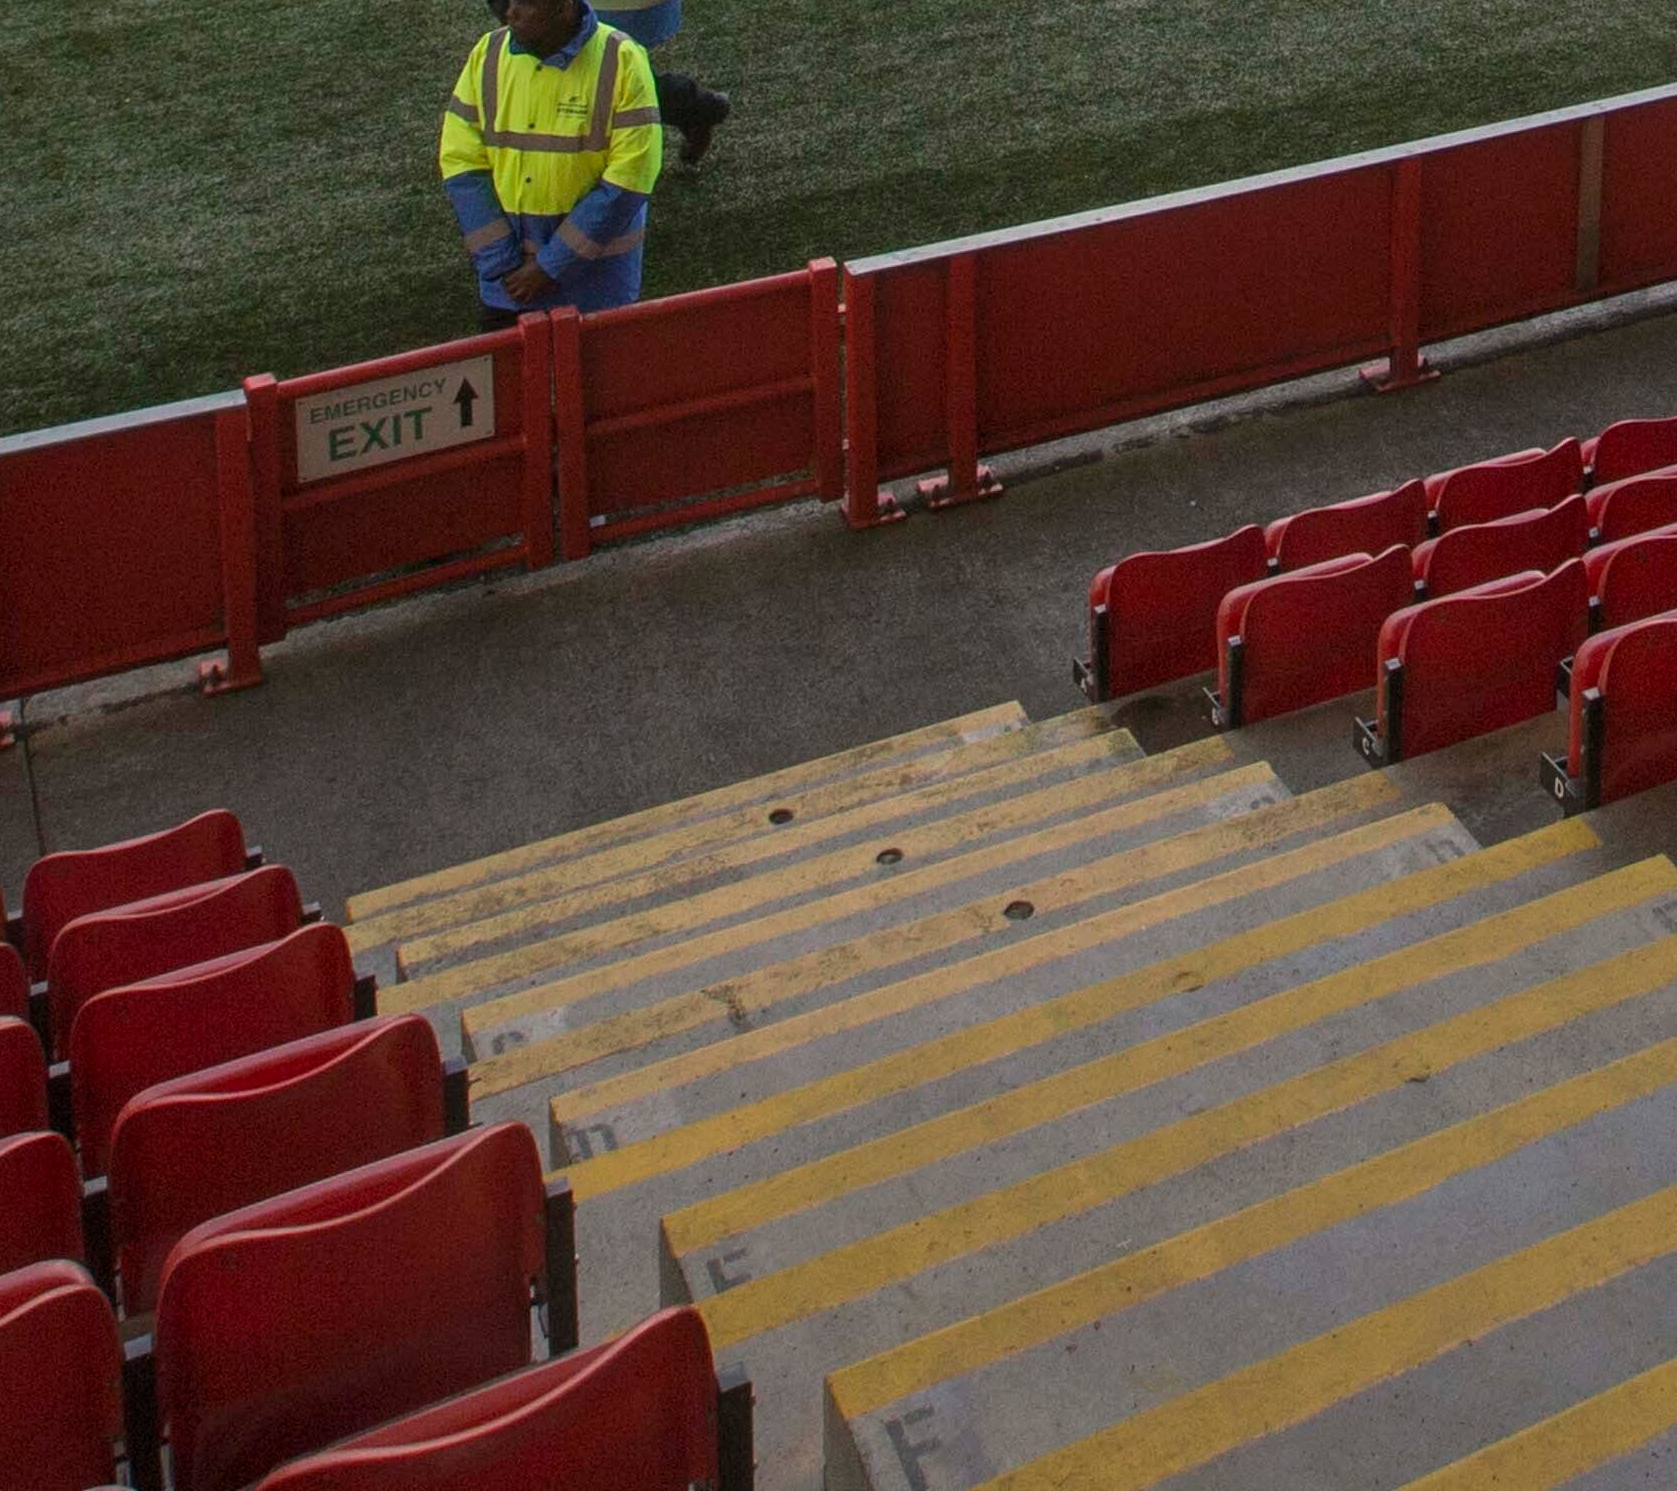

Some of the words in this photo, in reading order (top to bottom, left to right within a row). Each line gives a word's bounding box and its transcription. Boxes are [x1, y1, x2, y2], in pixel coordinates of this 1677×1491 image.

[309, 377, 447, 425] EMERGENCY
[327, 405, 433, 462] EXIT
[1554, 776, 1566, 799] D
